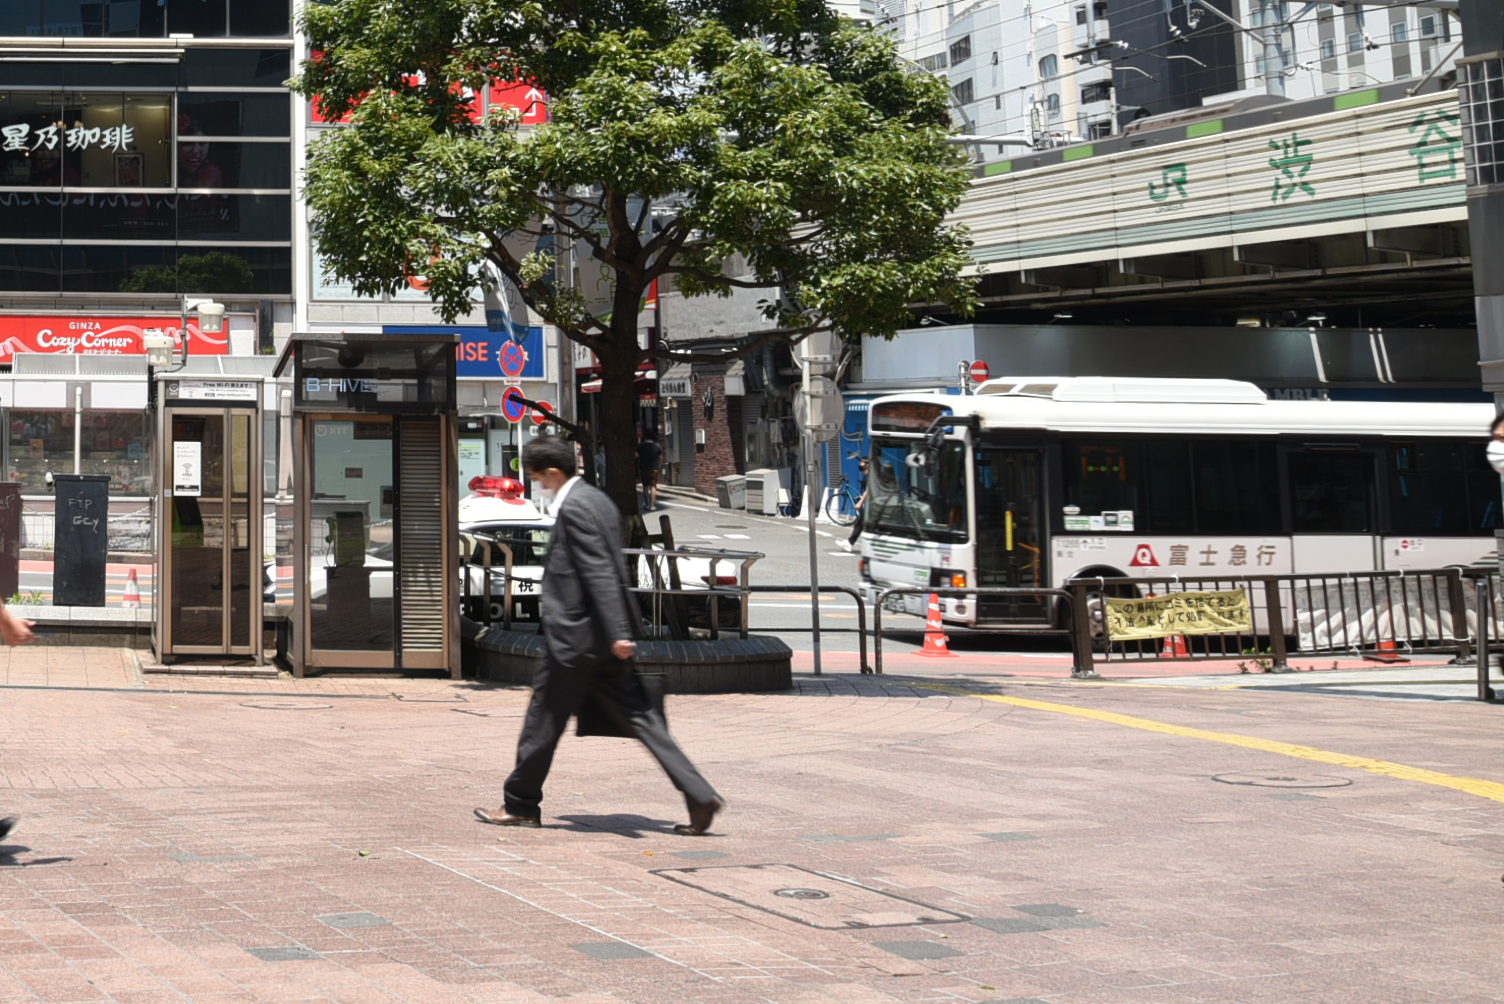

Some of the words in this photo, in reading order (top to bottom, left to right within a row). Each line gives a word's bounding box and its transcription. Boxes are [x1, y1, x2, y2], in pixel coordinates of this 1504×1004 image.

[0, 122, 135, 155] 星乃珈琲
[1147, 161, 1189, 203] JR
[69, 322, 101, 330] GINZA
[36, 329, 81, 354] Cozy
[81, 331, 133, 348] Corner
[456, 341, 490, 362] ISE
[306, 377, 377, 393] B-HIVE
[1168, 543, 1278, 567] 富士急行
